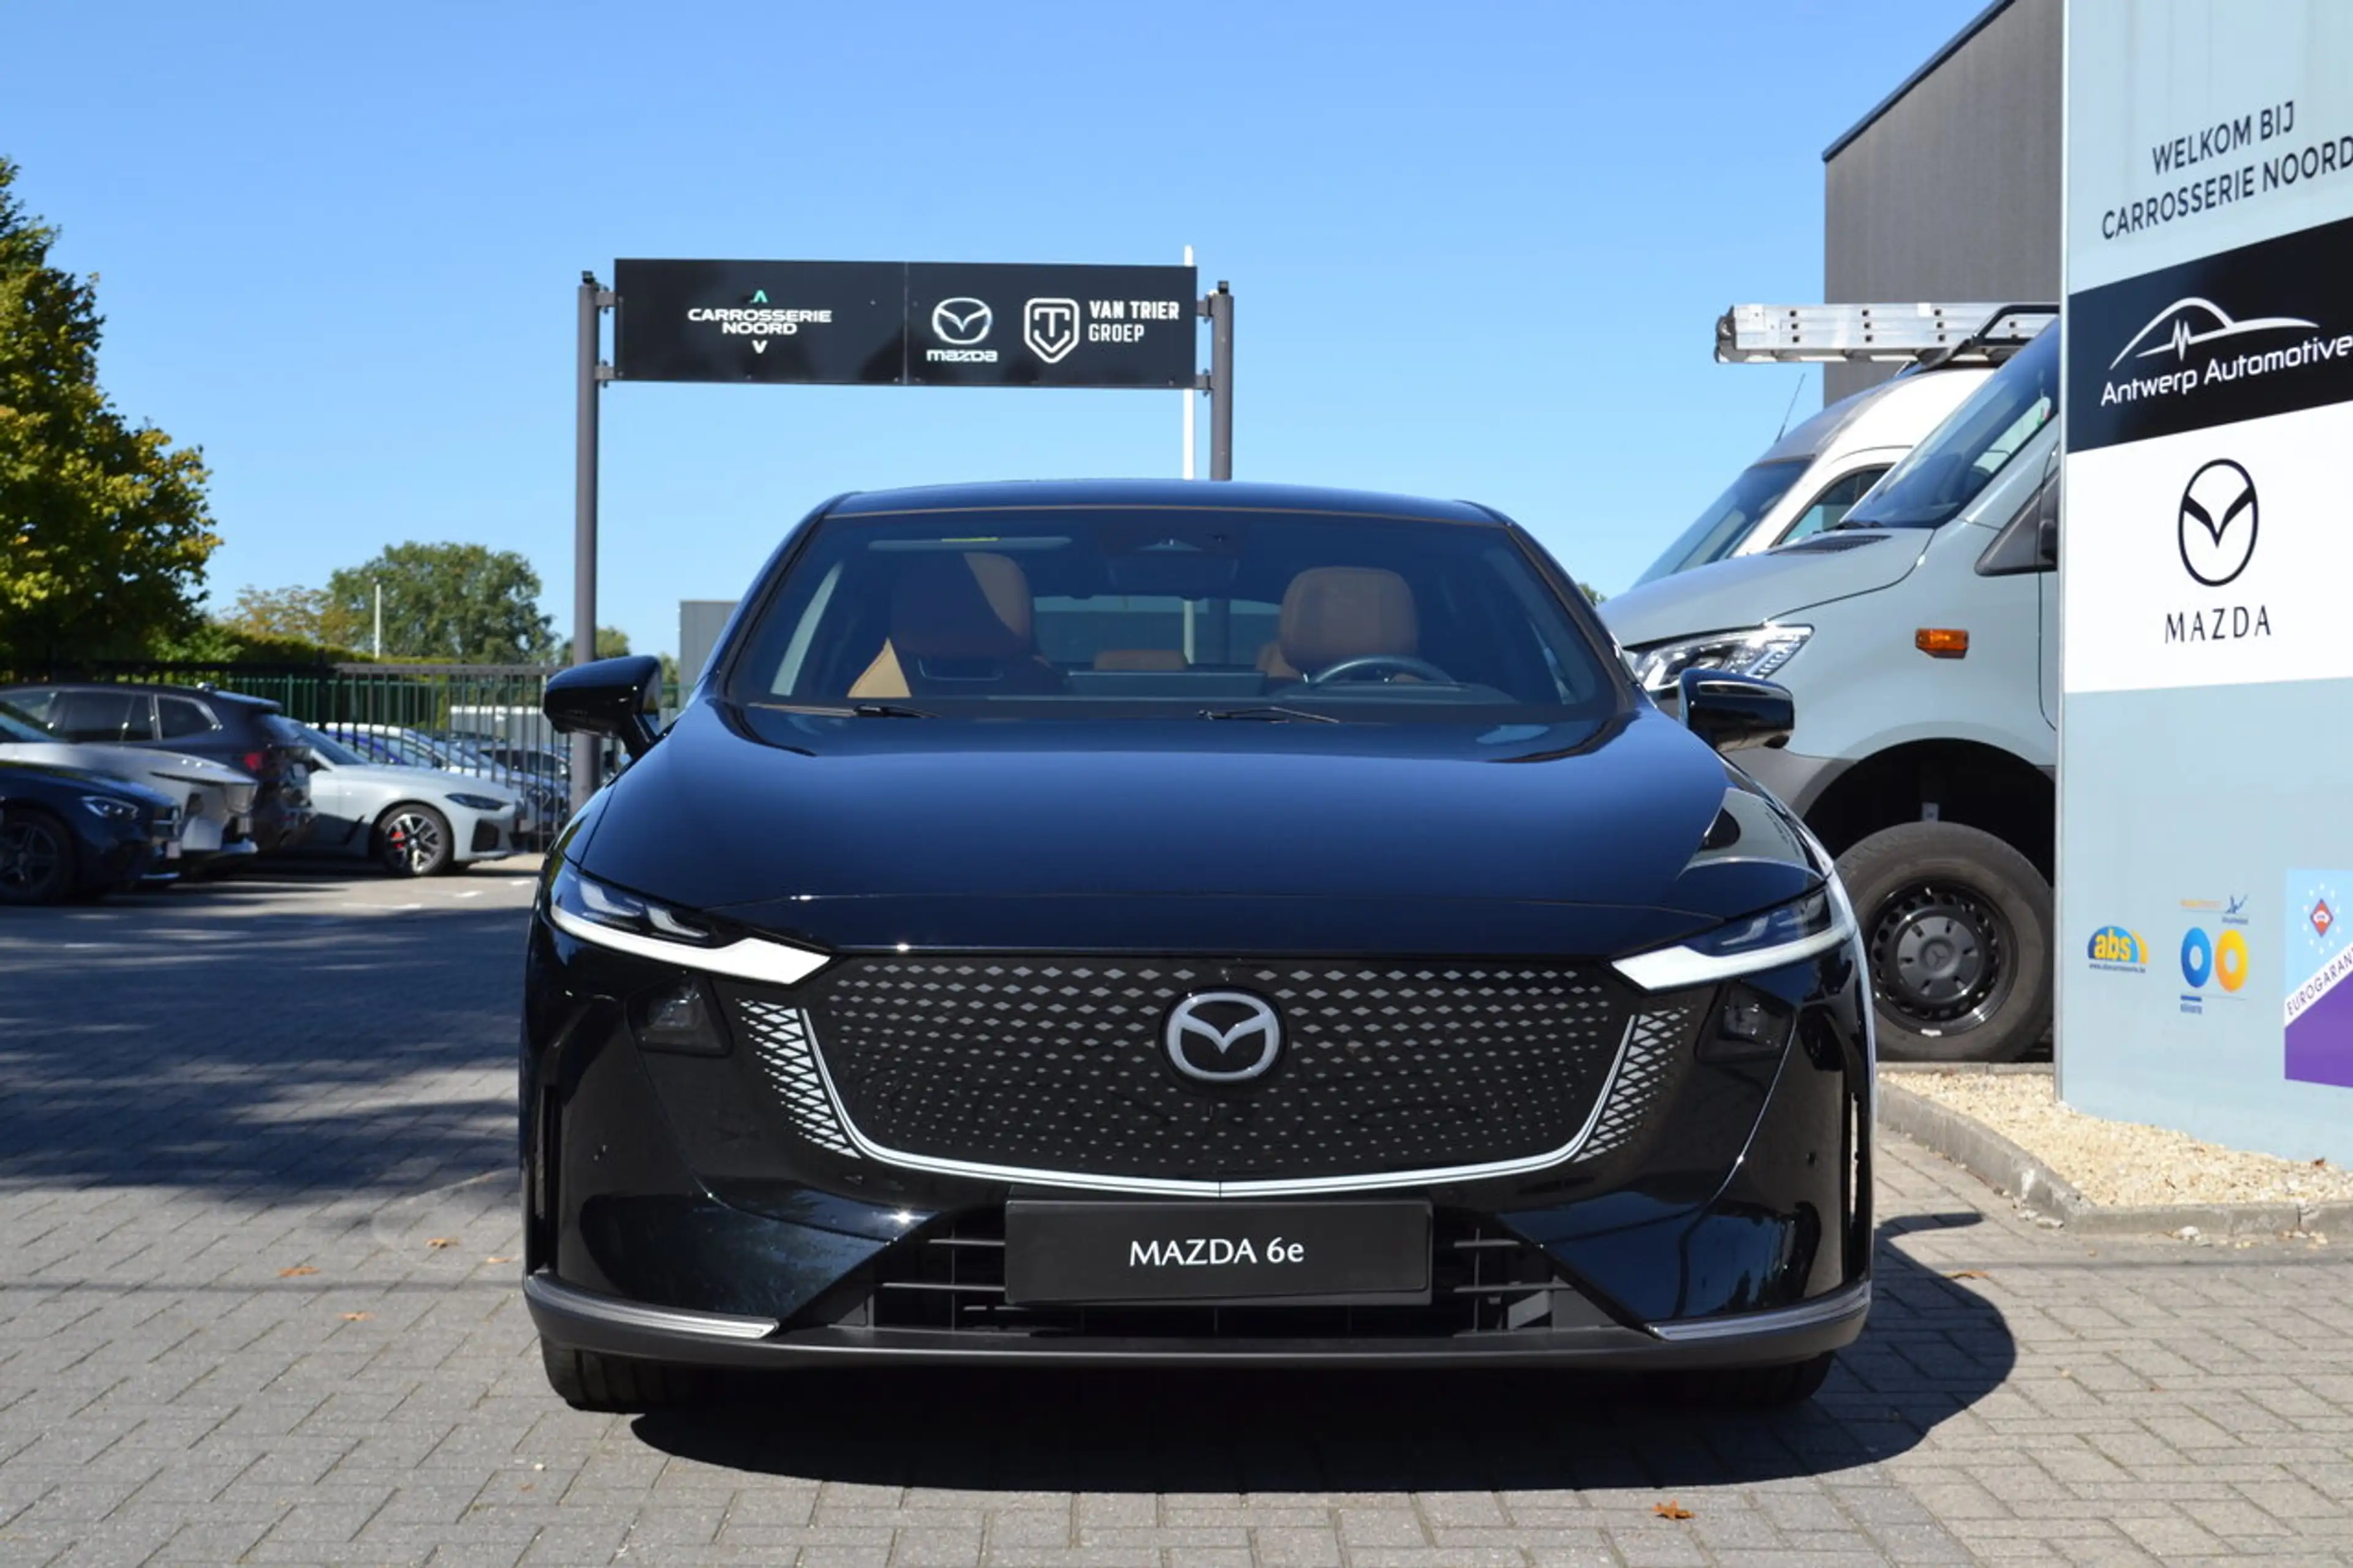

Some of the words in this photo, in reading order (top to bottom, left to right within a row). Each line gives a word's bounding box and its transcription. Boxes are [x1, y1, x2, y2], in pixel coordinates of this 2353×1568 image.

[2152, 115, 2251, 175] WELKOM
[2260, 100, 2294, 141] BIJ
[2102, 166, 2255, 240] CARROSSERIE
[2263, 135, 2353, 192] NOORD
[688, 308, 832, 323] CARROSSERIE
[1088, 300, 1124, 319] VAN
[1129, 301, 1180, 320] TRIER
[722, 322, 798, 335] NOORD
[1088, 323, 1145, 343] GROEP
[2101, 369, 2198, 407] Antwerp
[2203, 335, 2353, 385] Automotive
[2164, 605, 2272, 644] MAZDA
[2094, 927, 2131, 961] abs
[2286, 947, 2353, 1015] EUROGARAN
[1129, 1238, 1257, 1267] MAZDA
[1266, 1237, 1305, 1263] 6e
